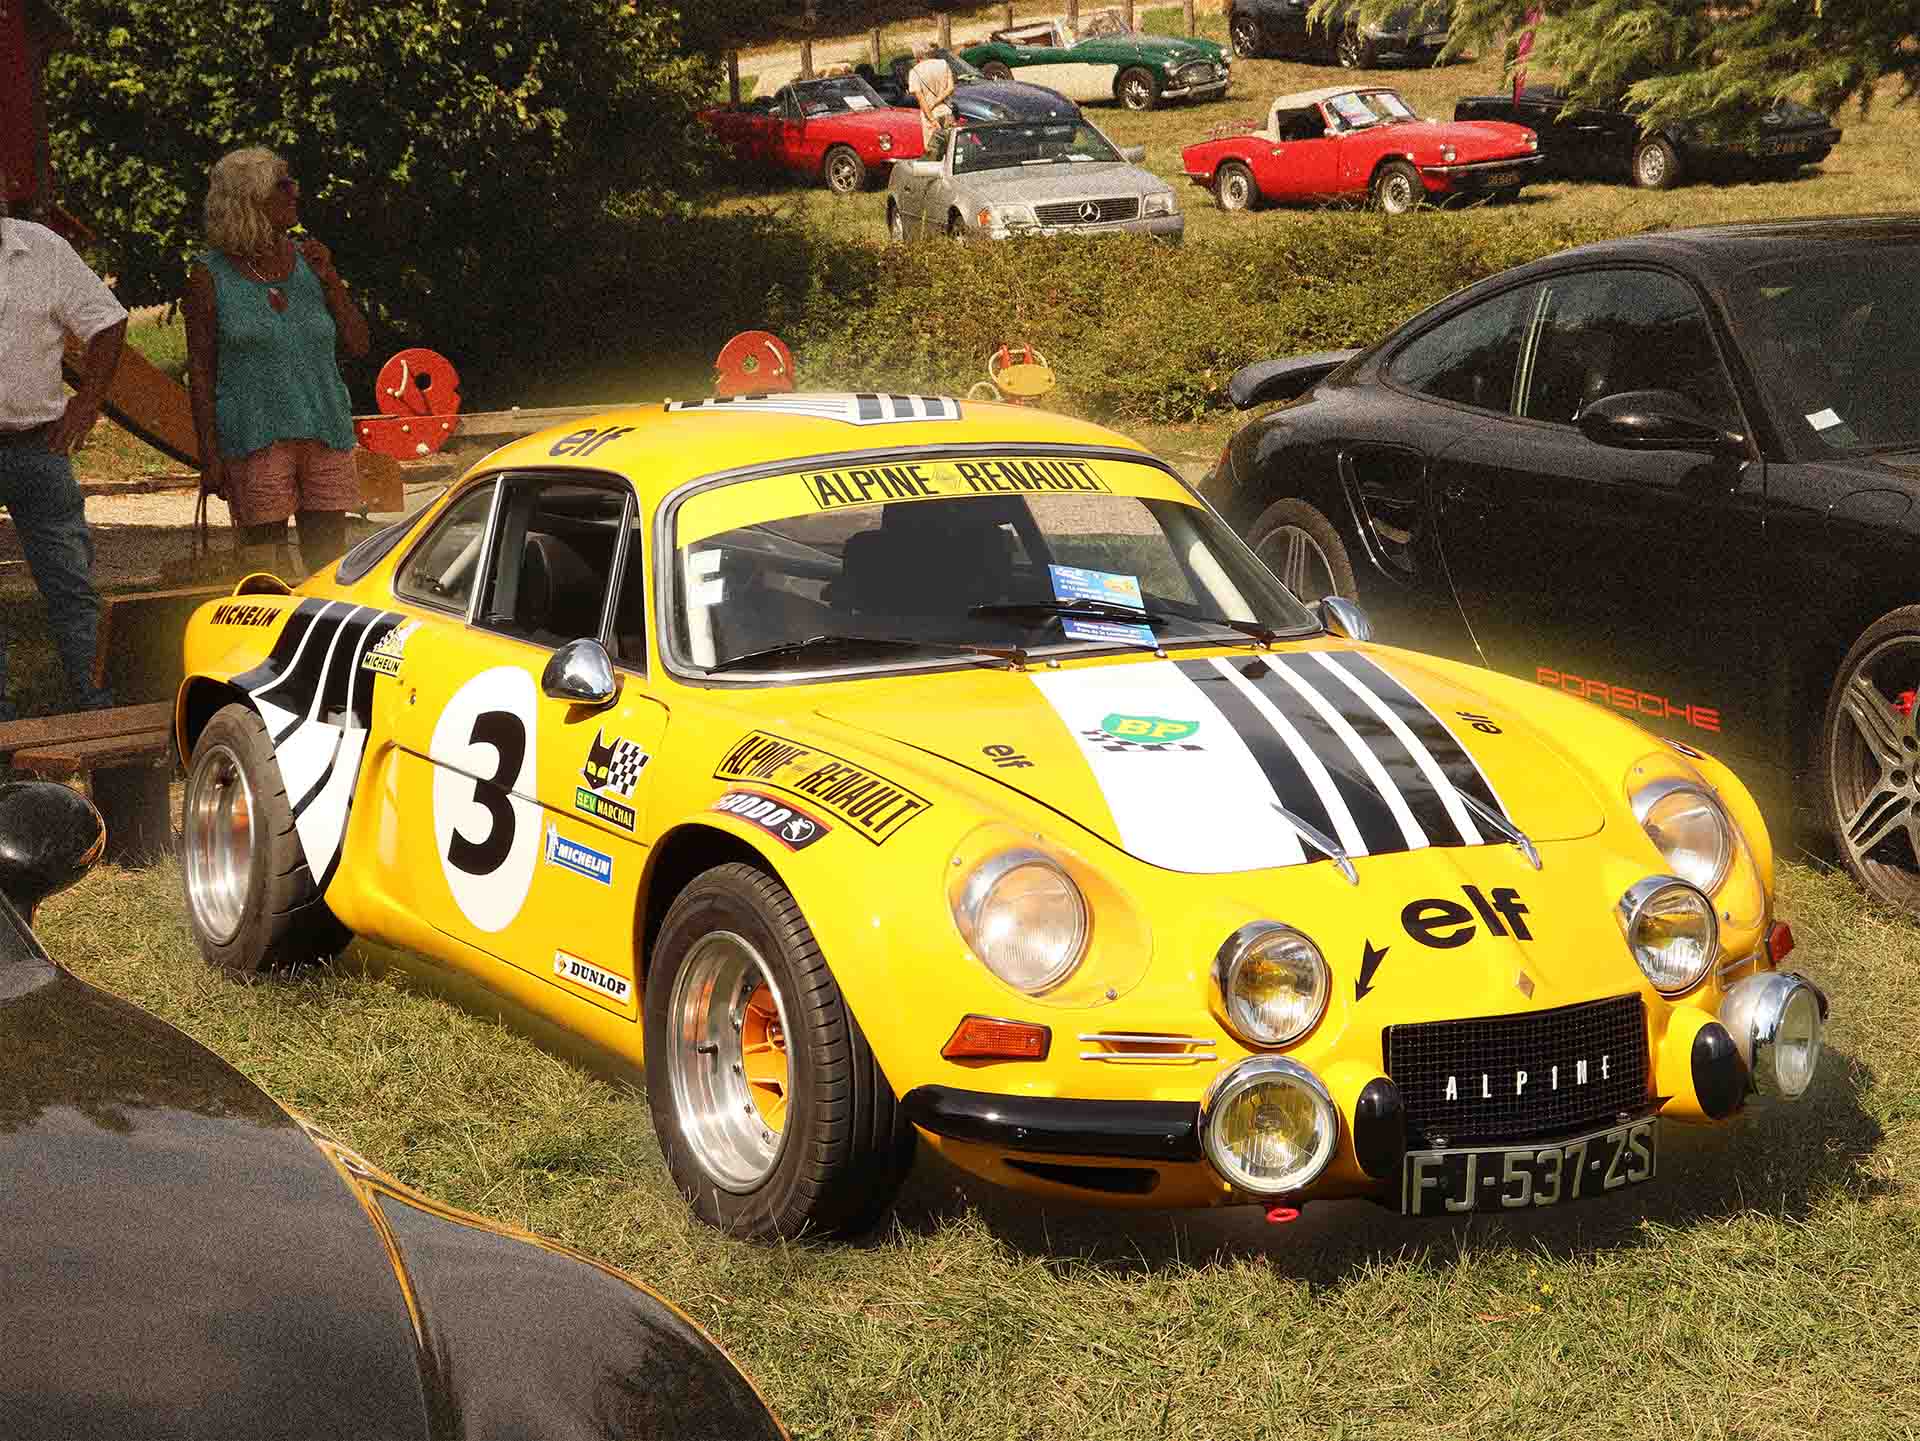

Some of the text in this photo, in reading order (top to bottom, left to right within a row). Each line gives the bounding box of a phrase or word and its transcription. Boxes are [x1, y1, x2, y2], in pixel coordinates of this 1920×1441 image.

[549, 426, 636, 456] elf
[813, 460, 1101, 506] ALPINE RENAULT
[210, 604, 281, 628] MICHELIN
[363, 654, 401, 673] MICHELIN
[1536, 666, 1721, 732] PORSCHE
[1114, 718, 1191, 739] BP
[1456, 710, 1503, 735] elf
[982, 743, 1036, 769] elf
[447, 710, 527, 876] 3
[720, 735, 921, 834] ALPINE RENAULT
[597, 799, 634, 828] MARCHAL
[557, 843, 611, 876] MICHELIN
[1401, 885, 1533, 949] elf
[570, 961, 627, 995] DUNLOP
[1446, 1055, 1610, 1101] ALPINE
[1411, 1123, 1652, 1216] FJ-537-ZS
